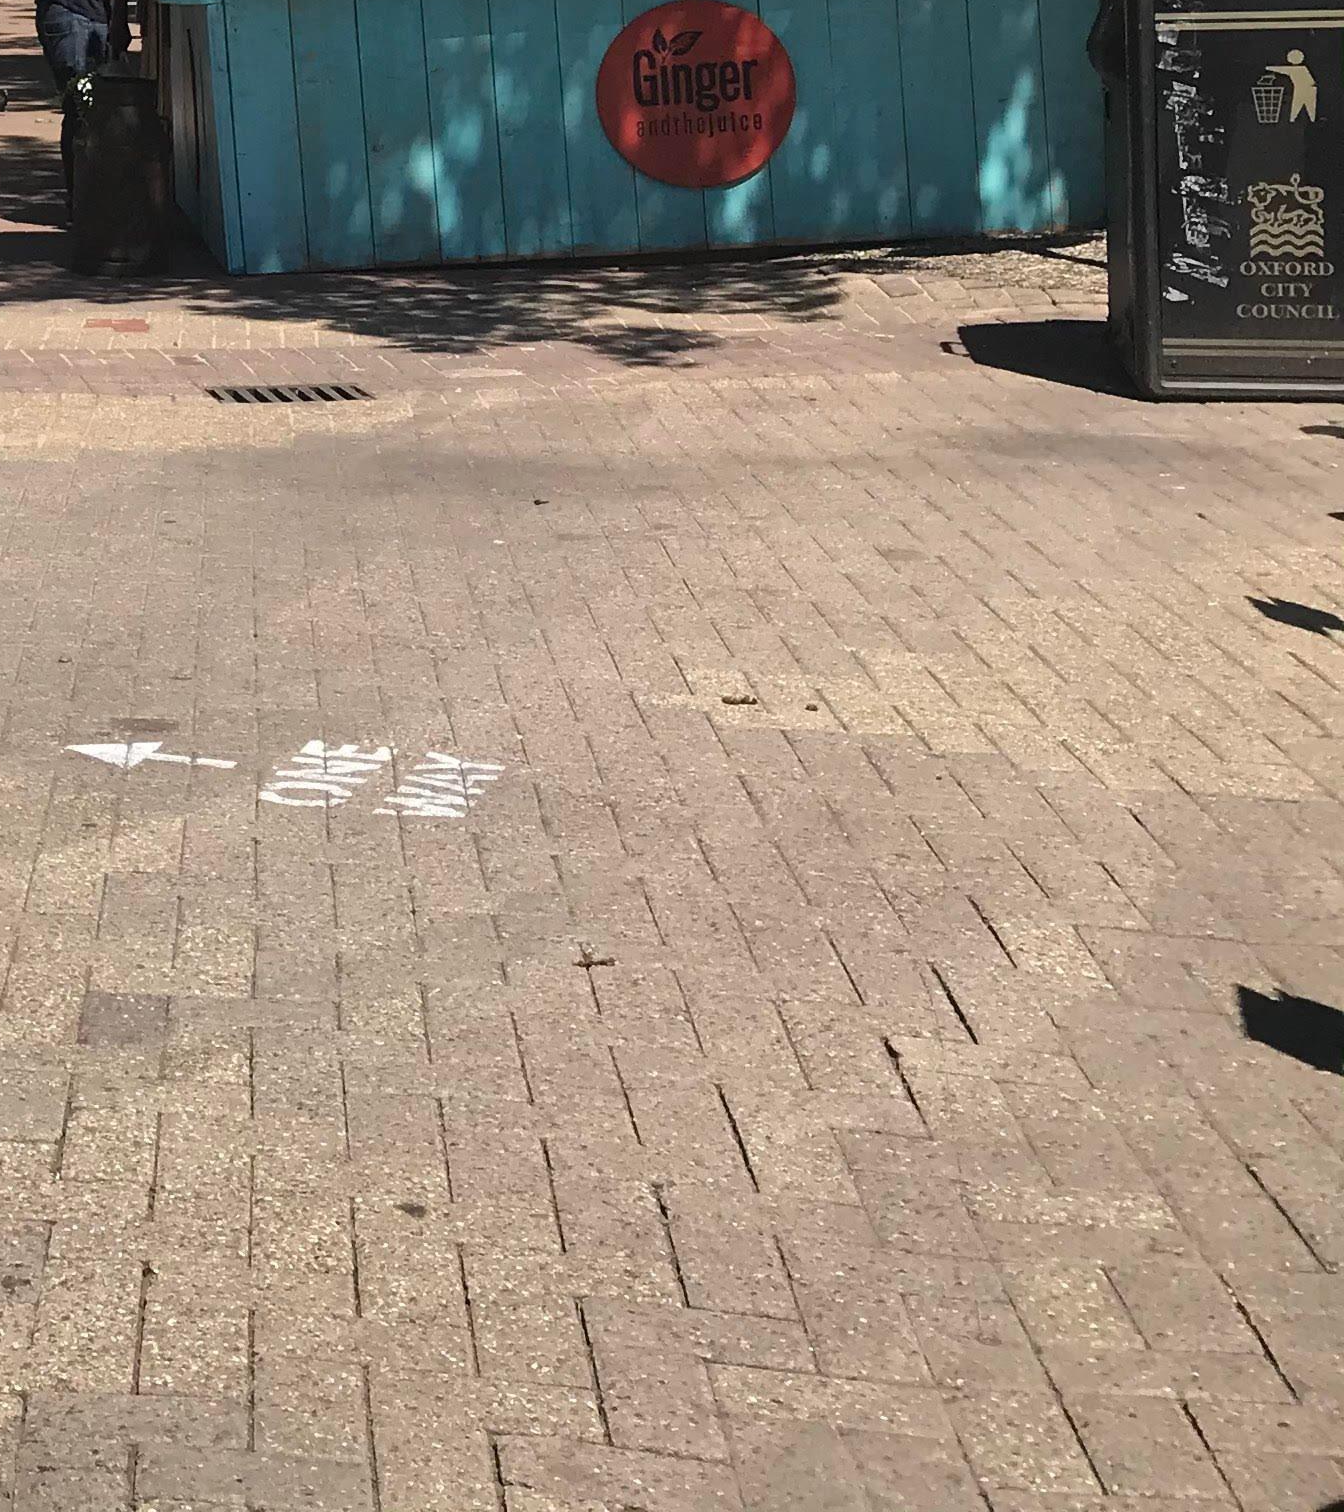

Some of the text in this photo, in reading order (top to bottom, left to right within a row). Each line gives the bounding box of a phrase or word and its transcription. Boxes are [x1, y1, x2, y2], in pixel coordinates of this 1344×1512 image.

[633, 49, 759, 113] Ginger
[1239, 261, 1334, 277] OXFORD
[1260, 283, 1313, 298] CITY
[1236, 303, 1341, 320] COUNCIL
[258, 739, 398, 808] ONE
